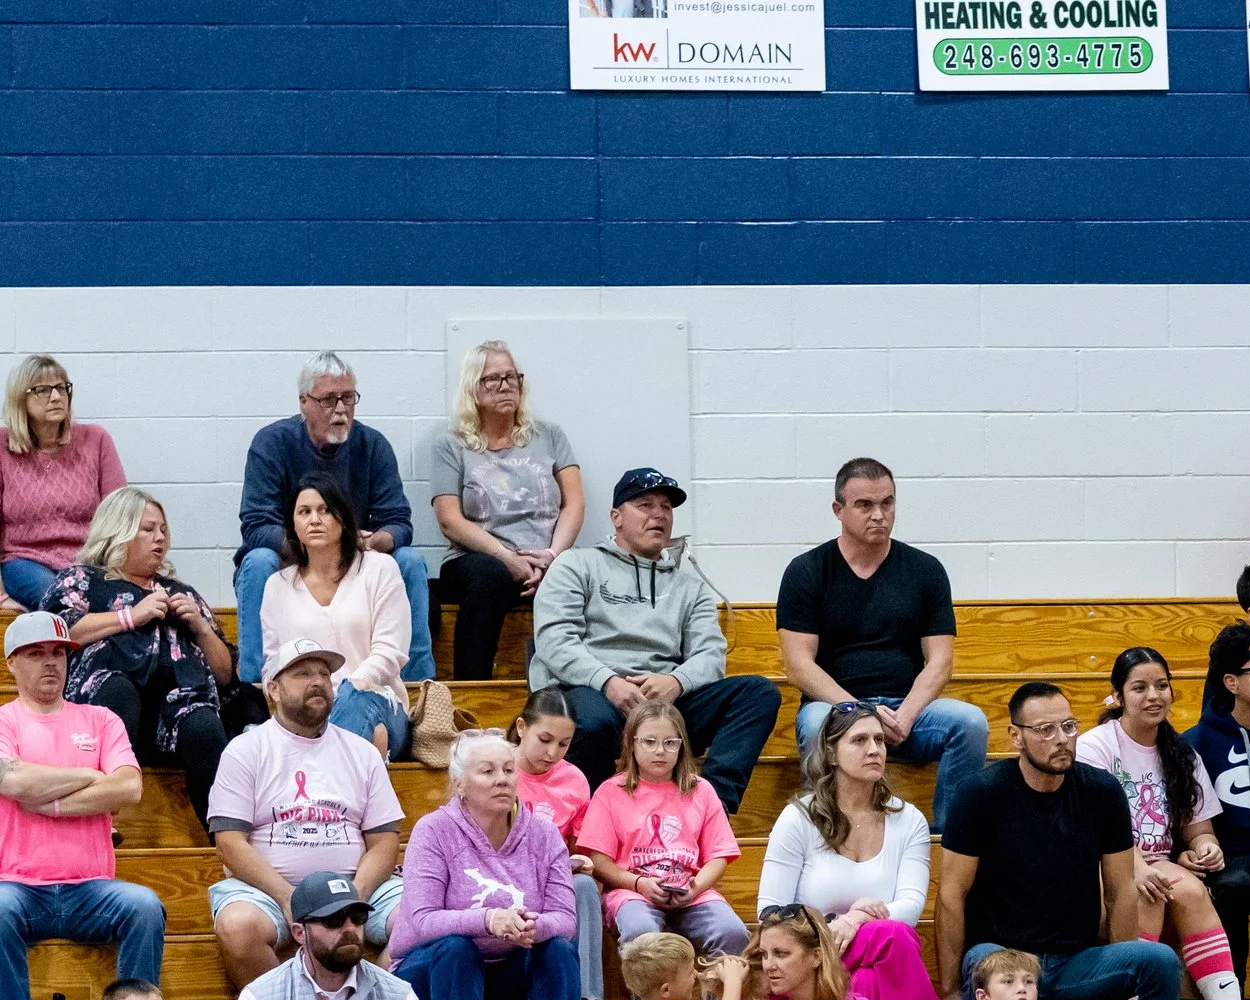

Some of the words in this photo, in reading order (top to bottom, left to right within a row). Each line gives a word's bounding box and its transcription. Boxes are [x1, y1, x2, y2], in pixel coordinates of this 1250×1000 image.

[674, 1, 815, 13] invest@jessicajuel.com
[925, 2, 1022, 29] HEATING
[1029, 1, 1048, 29] &
[1054, 1, 1158, 28] COOLING
[613, 33, 656, 62] kw
[678, 42, 792, 63] DOMAIN
[944, 43, 1142, 69] 248-693-4775
[614, 75, 656, 83] LUXURY
[661, 75, 700, 84] HOMES
[705, 76, 792, 84] INTERNATIONAL
